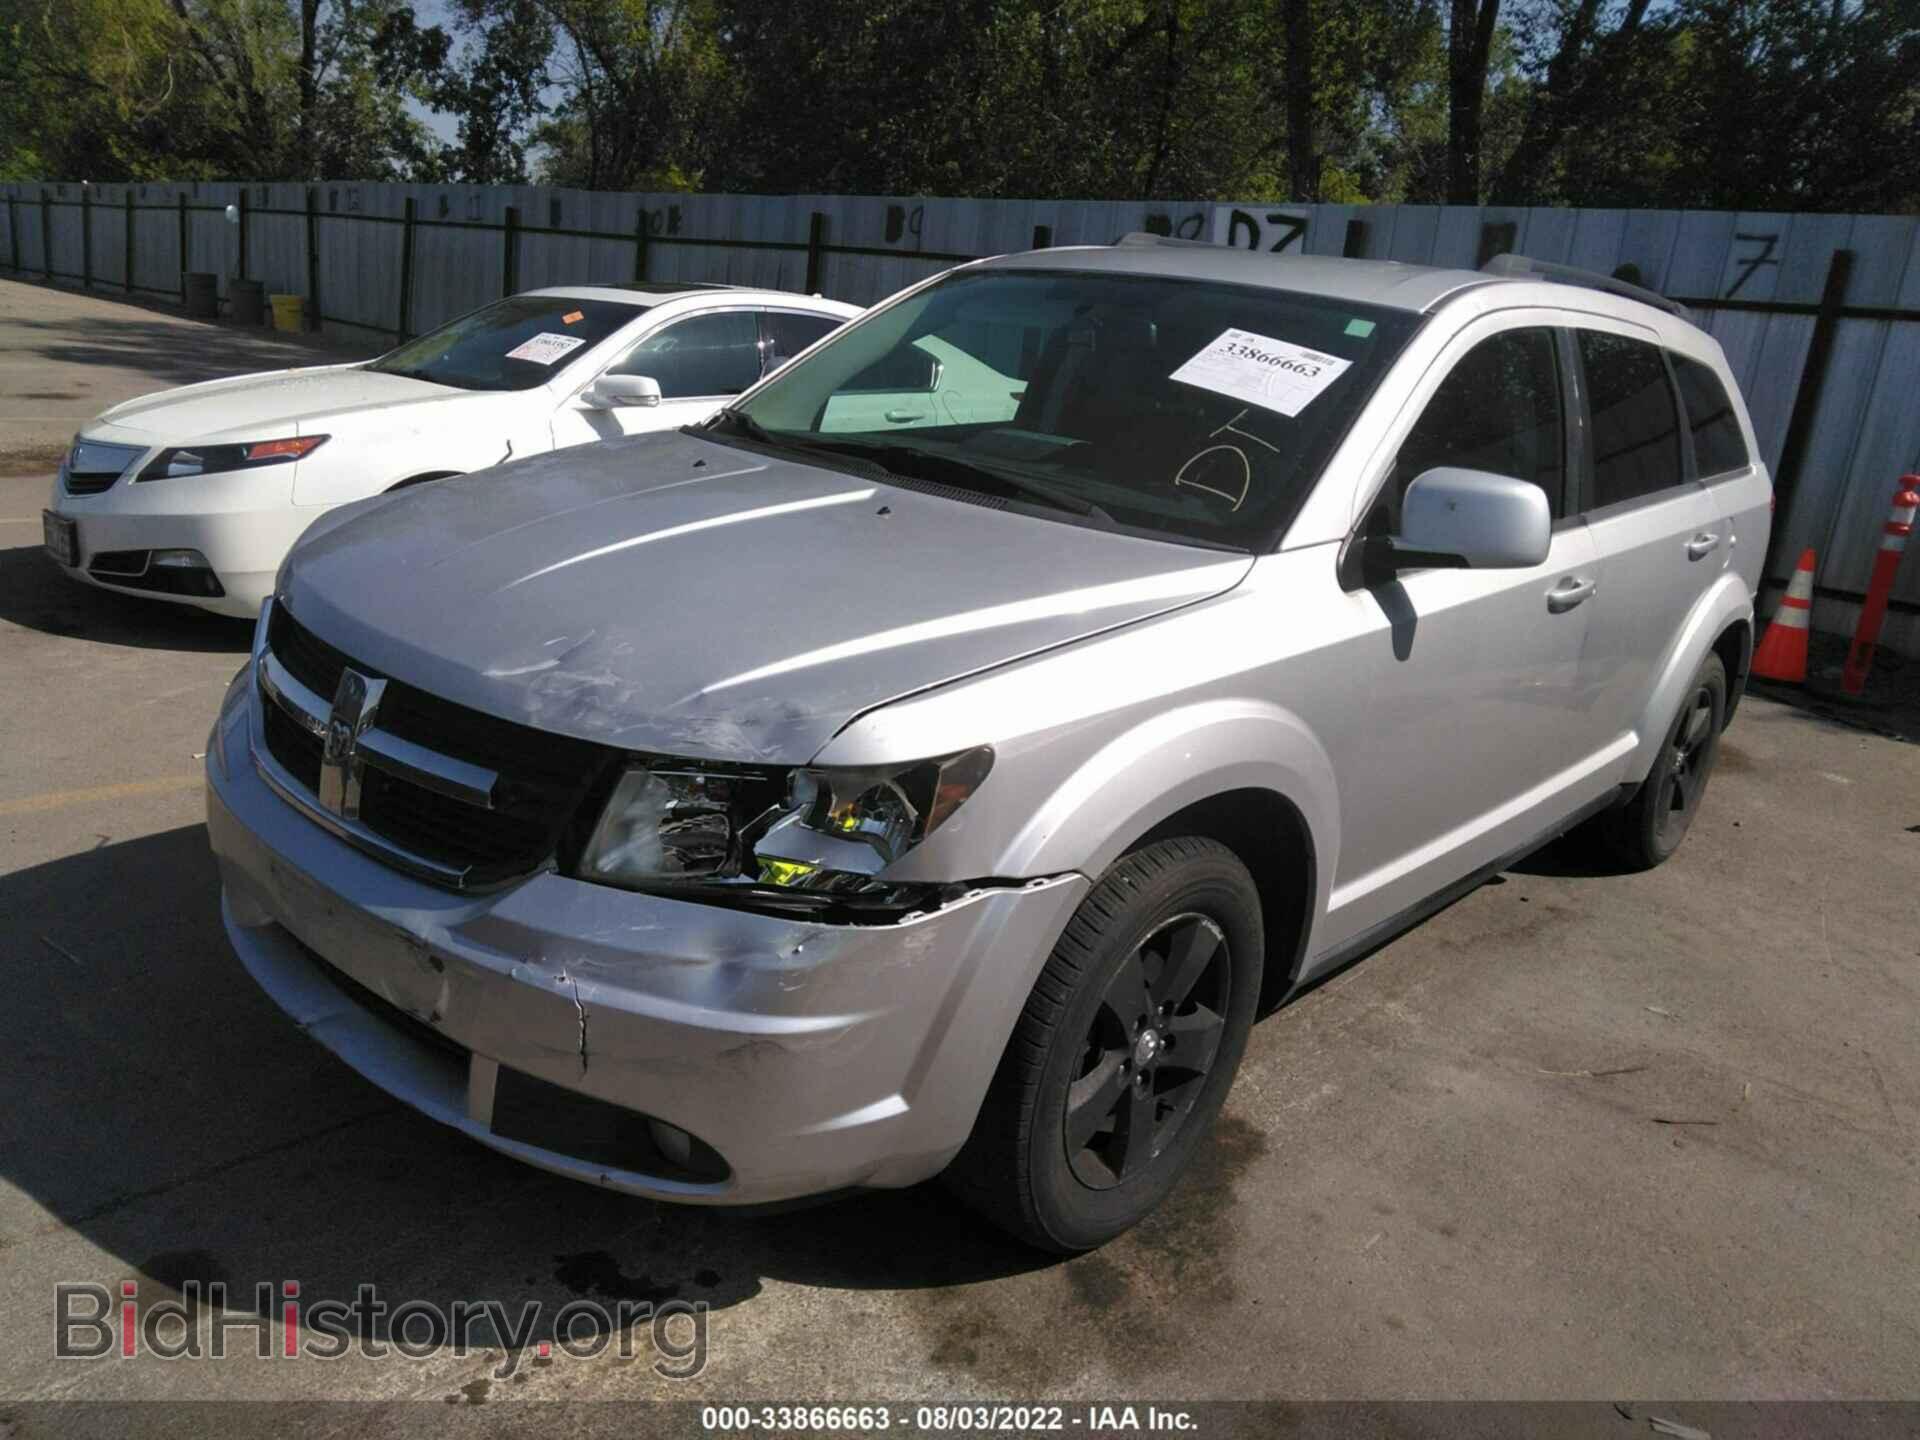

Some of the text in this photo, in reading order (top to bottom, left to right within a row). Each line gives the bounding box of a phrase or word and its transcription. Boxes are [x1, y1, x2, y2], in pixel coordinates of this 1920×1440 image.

[1228, 209, 1308, 253] D7
[1725, 232, 1779, 299] 7
[1218, 342, 1321, 378] 33866663
